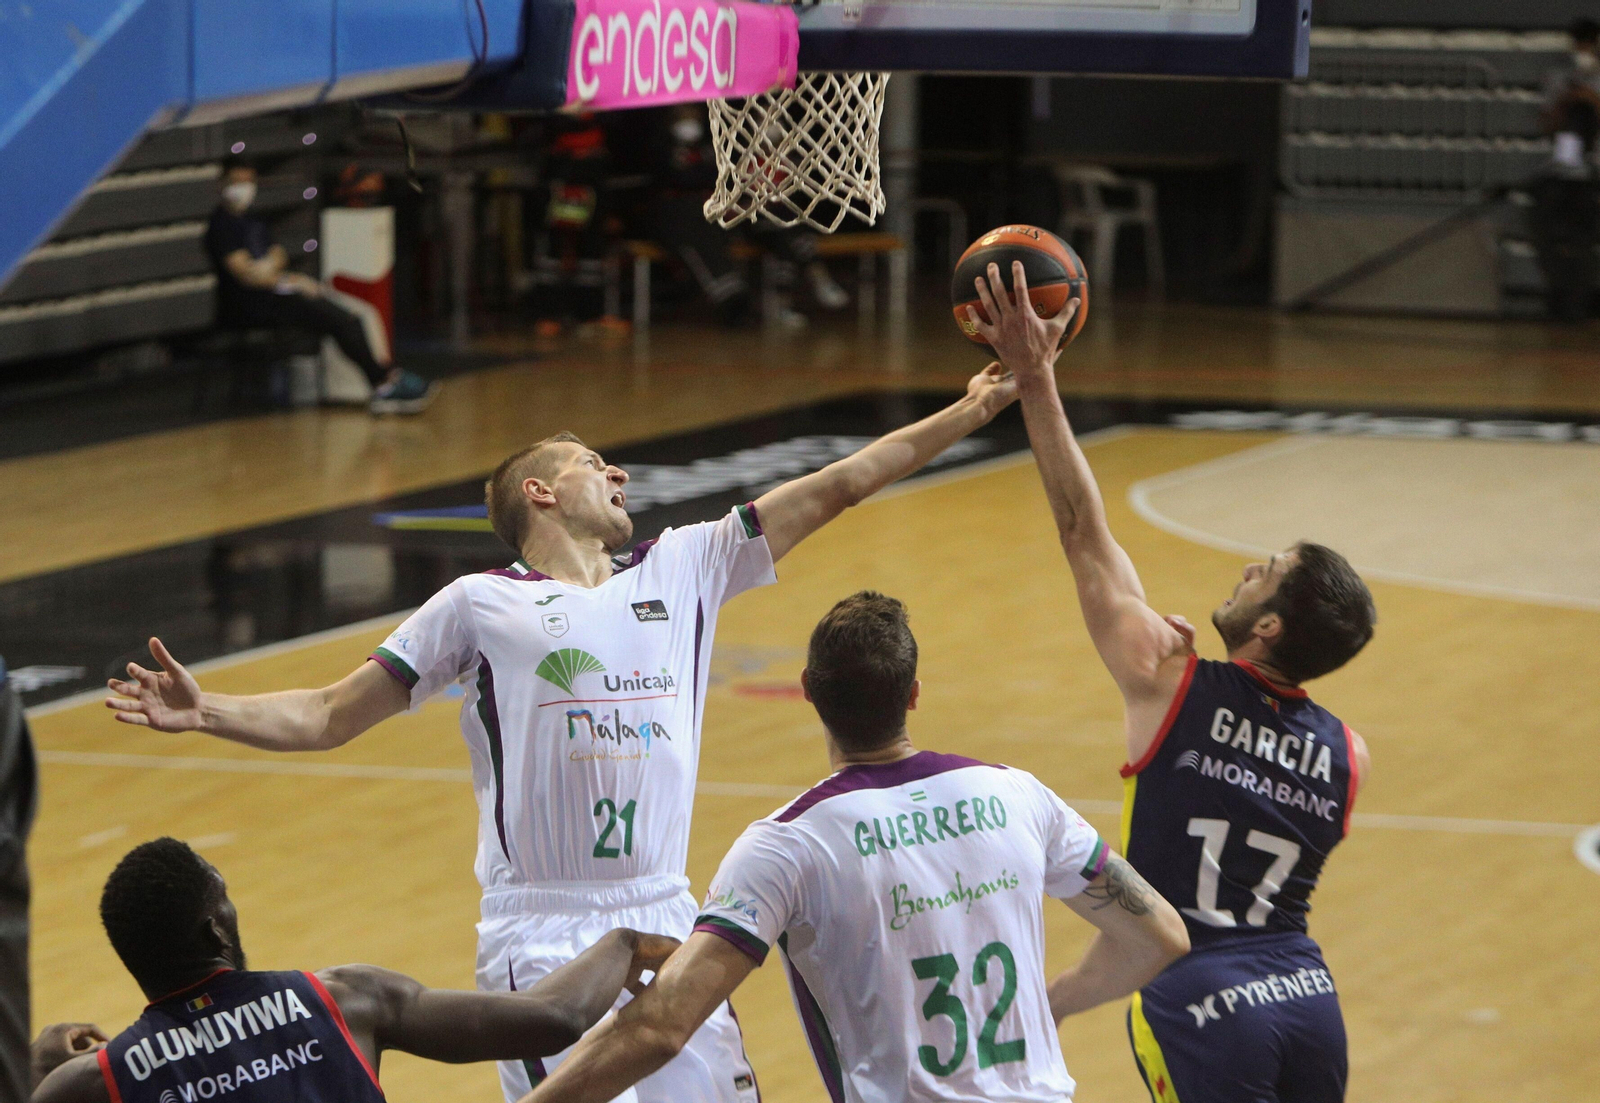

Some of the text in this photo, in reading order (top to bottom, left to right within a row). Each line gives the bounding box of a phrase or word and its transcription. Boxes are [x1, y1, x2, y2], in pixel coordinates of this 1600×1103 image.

[575, 0, 737, 100] endesa
[603, 667, 676, 693] Unicaja
[565, 708, 672, 751] Málaga
[1210, 706, 1333, 784] GARCÍA
[1200, 754, 1339, 823] MORABANC
[592, 797, 637, 858] 21
[854, 795, 1007, 857] GUERRERO
[1179, 817, 1301, 928] 17
[123, 988, 313, 1082] OLUMUYIWA
[911, 941, 1026, 1078] 32
[177, 1038, 324, 1103] MORABANC
